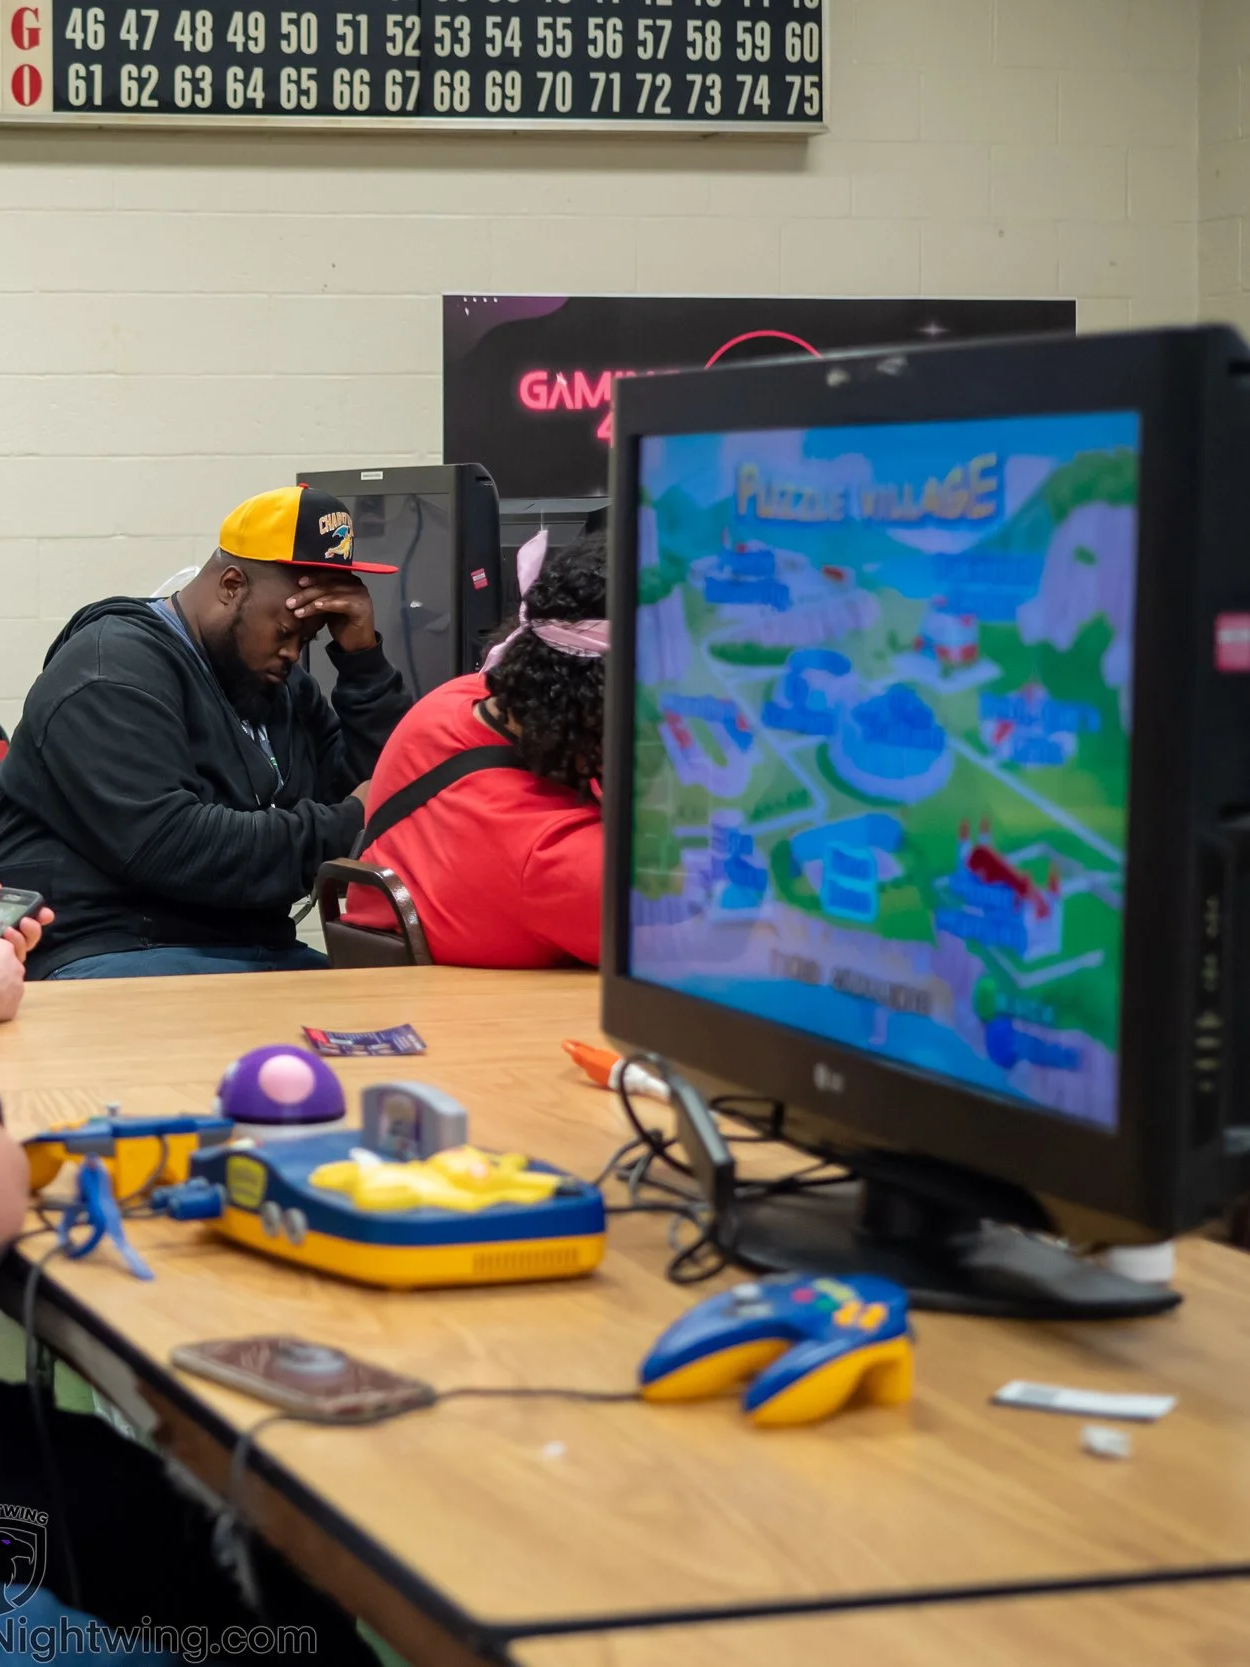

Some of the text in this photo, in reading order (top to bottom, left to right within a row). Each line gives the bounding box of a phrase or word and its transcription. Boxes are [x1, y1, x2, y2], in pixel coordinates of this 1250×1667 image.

[11, 6, 819, 63] G 46 47 48 49 50 51 52 53 54 55 56 57 58 59 60
[11, 63, 820, 116] O 61 62 63 64 65 66 67 68 69 70 71 72 73 74 75
